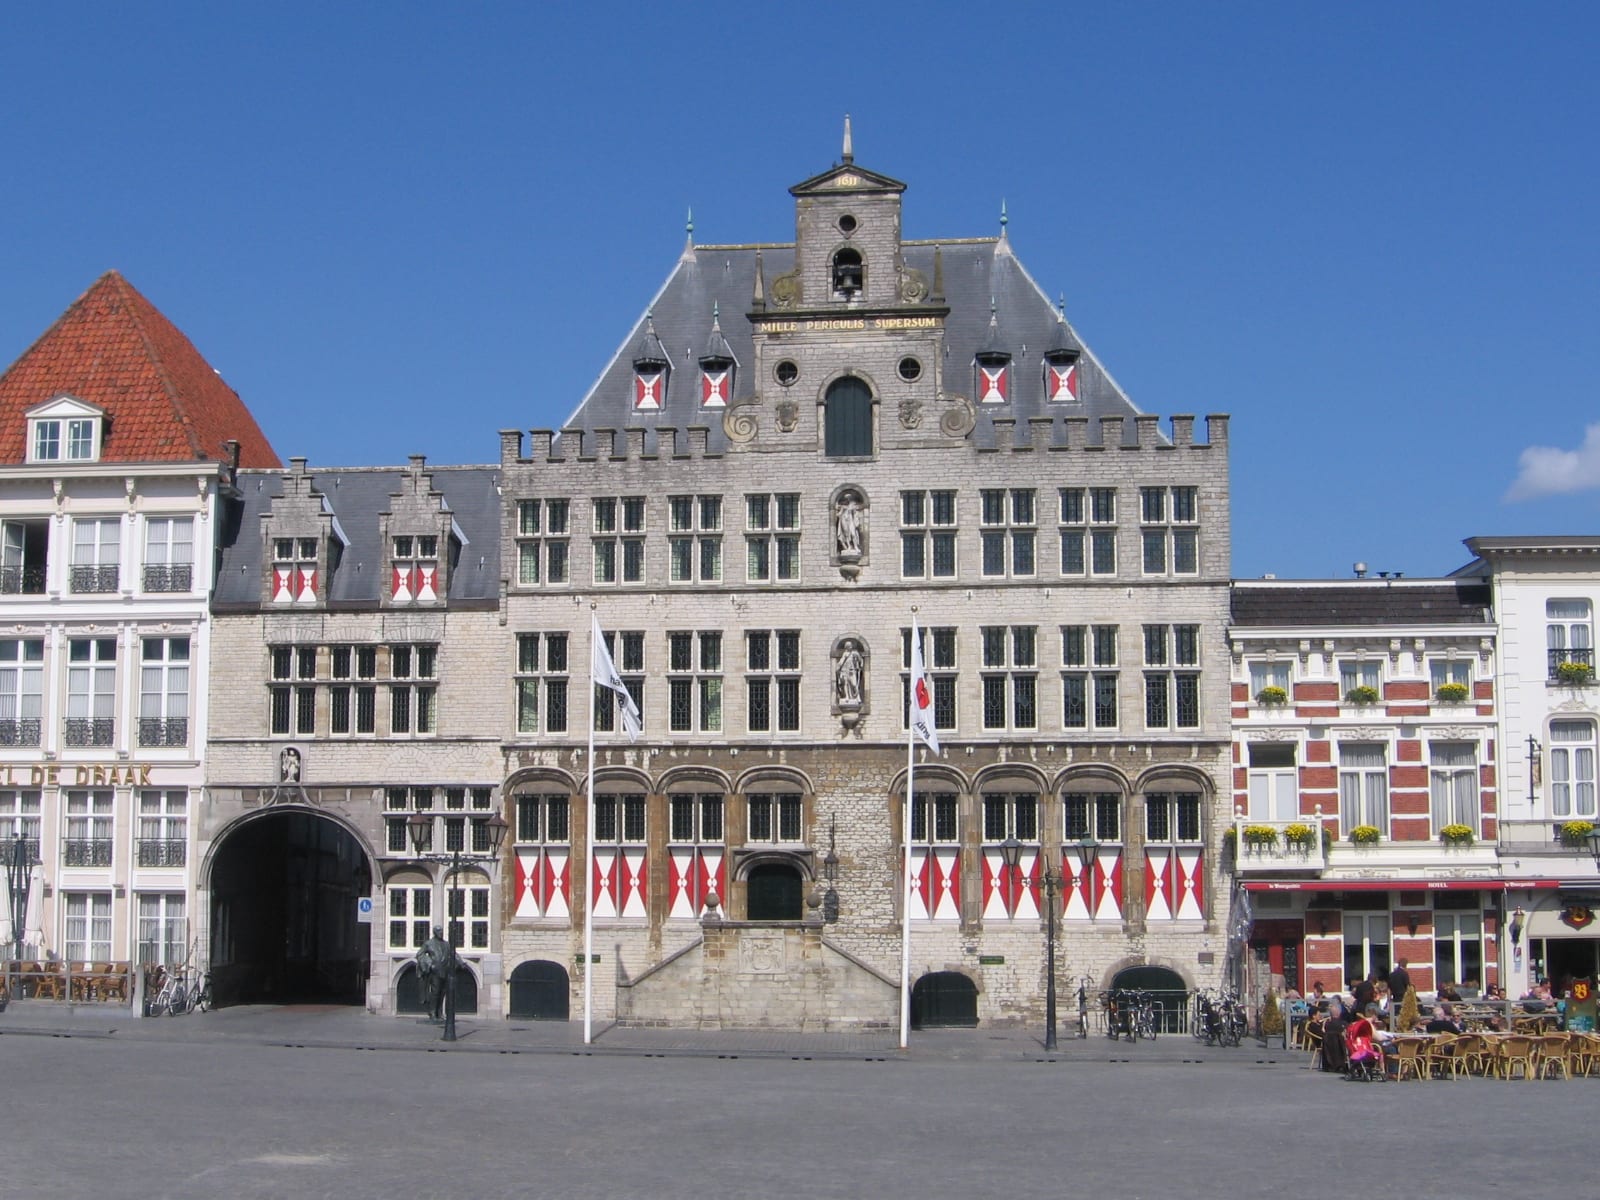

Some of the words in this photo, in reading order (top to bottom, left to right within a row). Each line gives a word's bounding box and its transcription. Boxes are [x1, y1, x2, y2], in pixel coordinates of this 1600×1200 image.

[837, 176, 857, 186] 1611
[761, 321, 798, 333] MILLE
[806, 319, 865, 331] PERICULIS
[874, 317, 936, 329] SUPERSUM
[0, 764, 17, 785] L
[31, 764, 60, 785] DE
[76, 764, 152, 785] DRAAK
